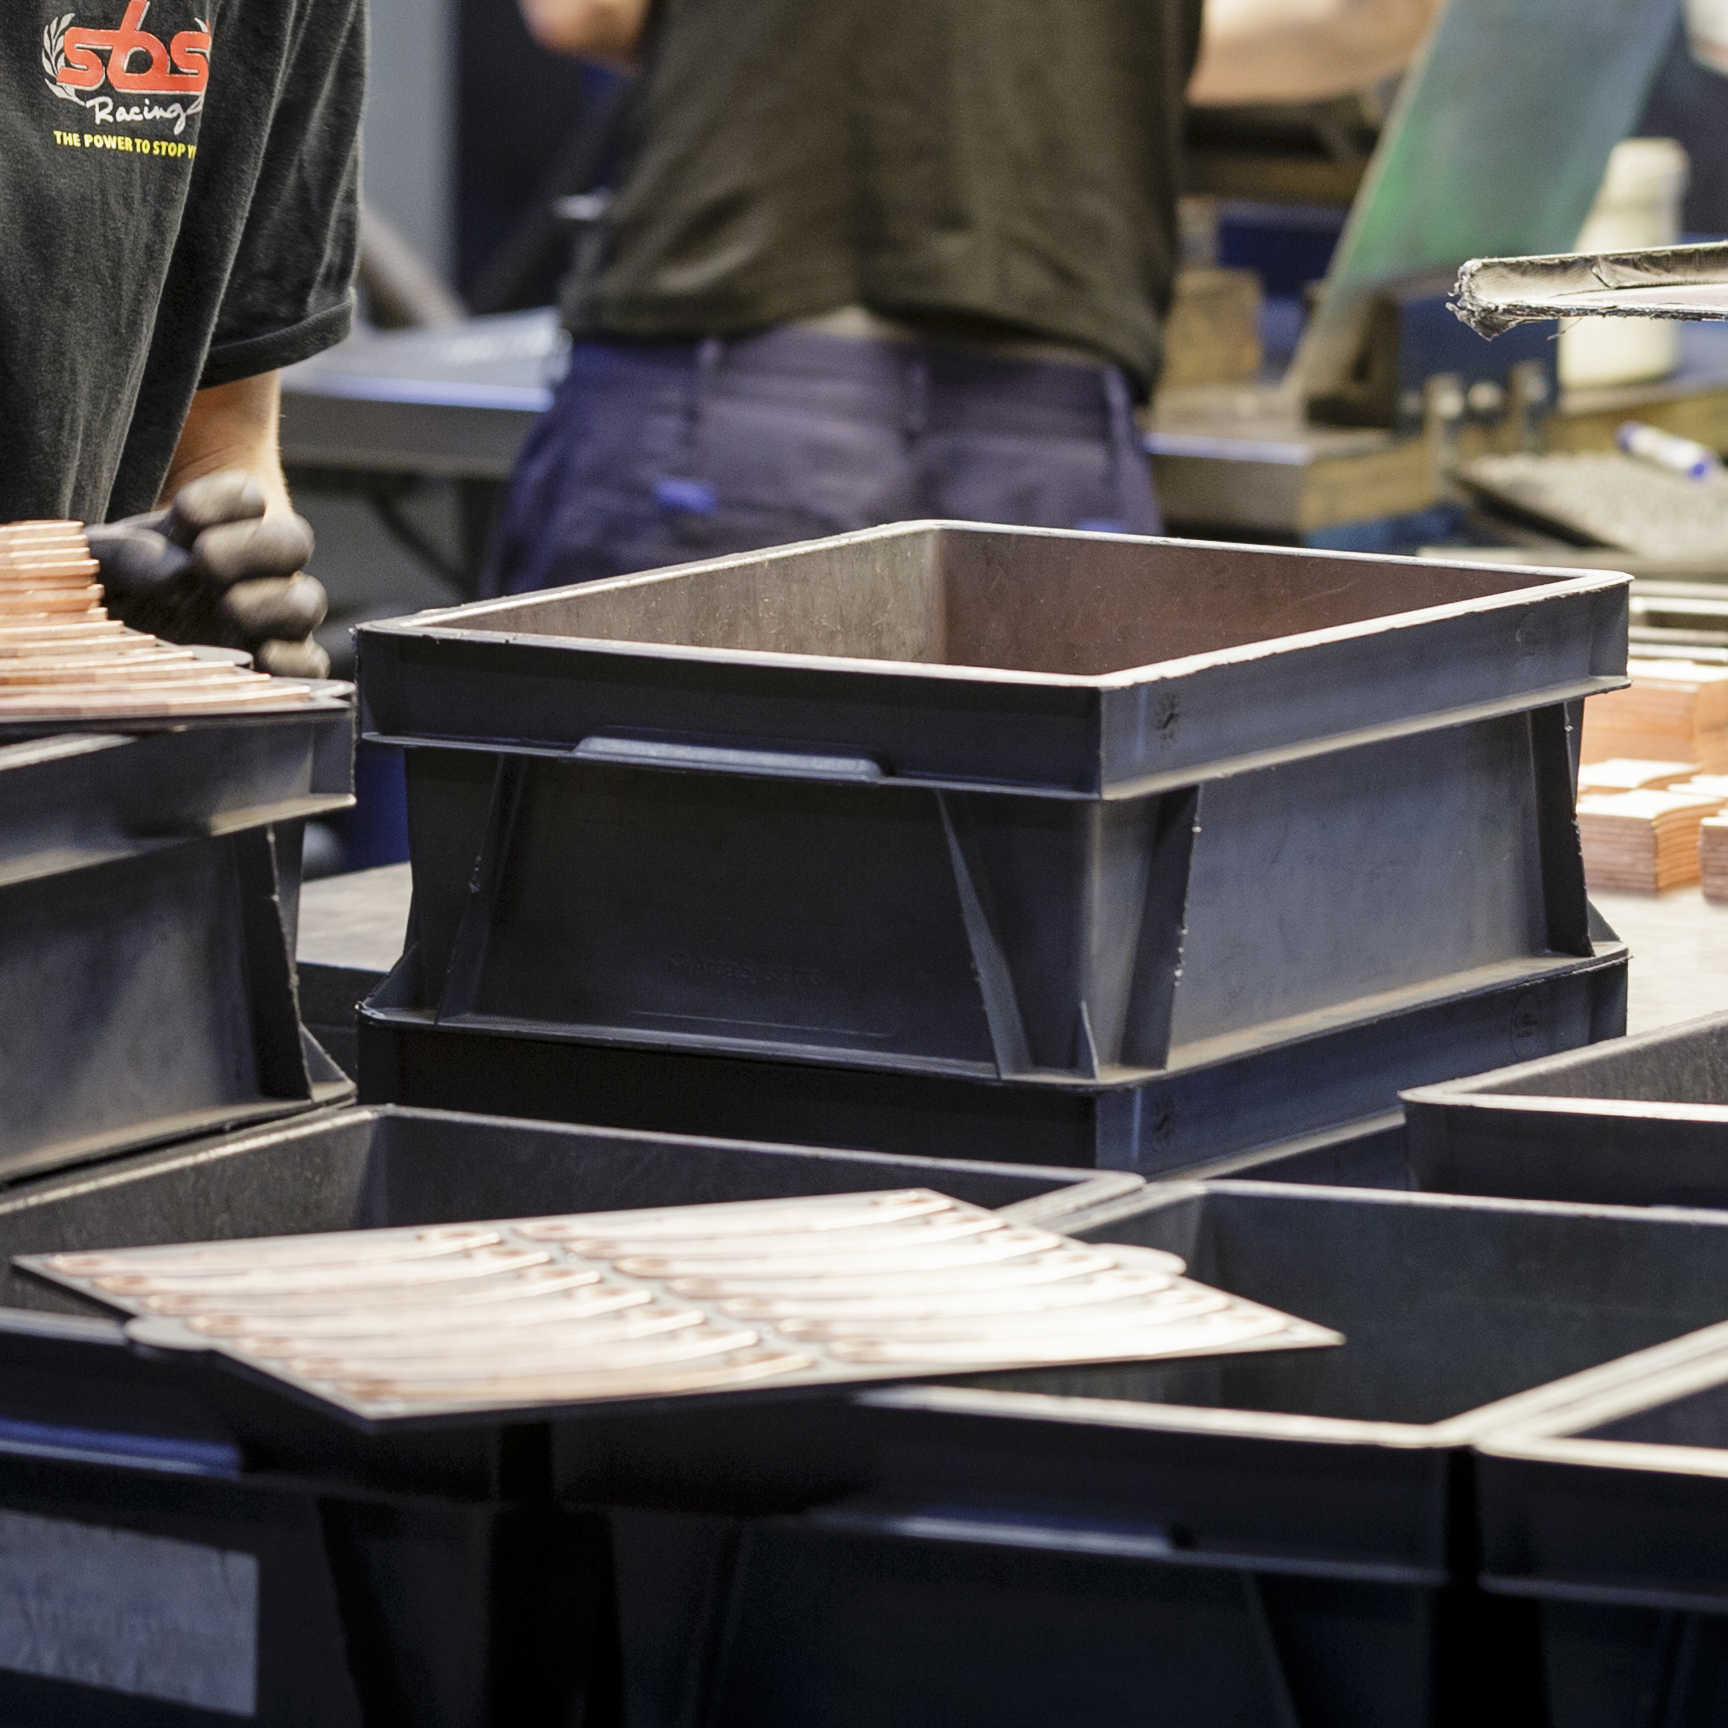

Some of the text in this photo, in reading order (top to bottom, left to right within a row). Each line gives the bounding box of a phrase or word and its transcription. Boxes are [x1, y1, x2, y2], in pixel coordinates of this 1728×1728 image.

[85, 96, 187, 135] Racing
[53, 130, 81, 147] THE
[84, 133, 133, 152] POWER
[134, 138, 150, 155] TO
[153, 140, 186, 158] STOP
